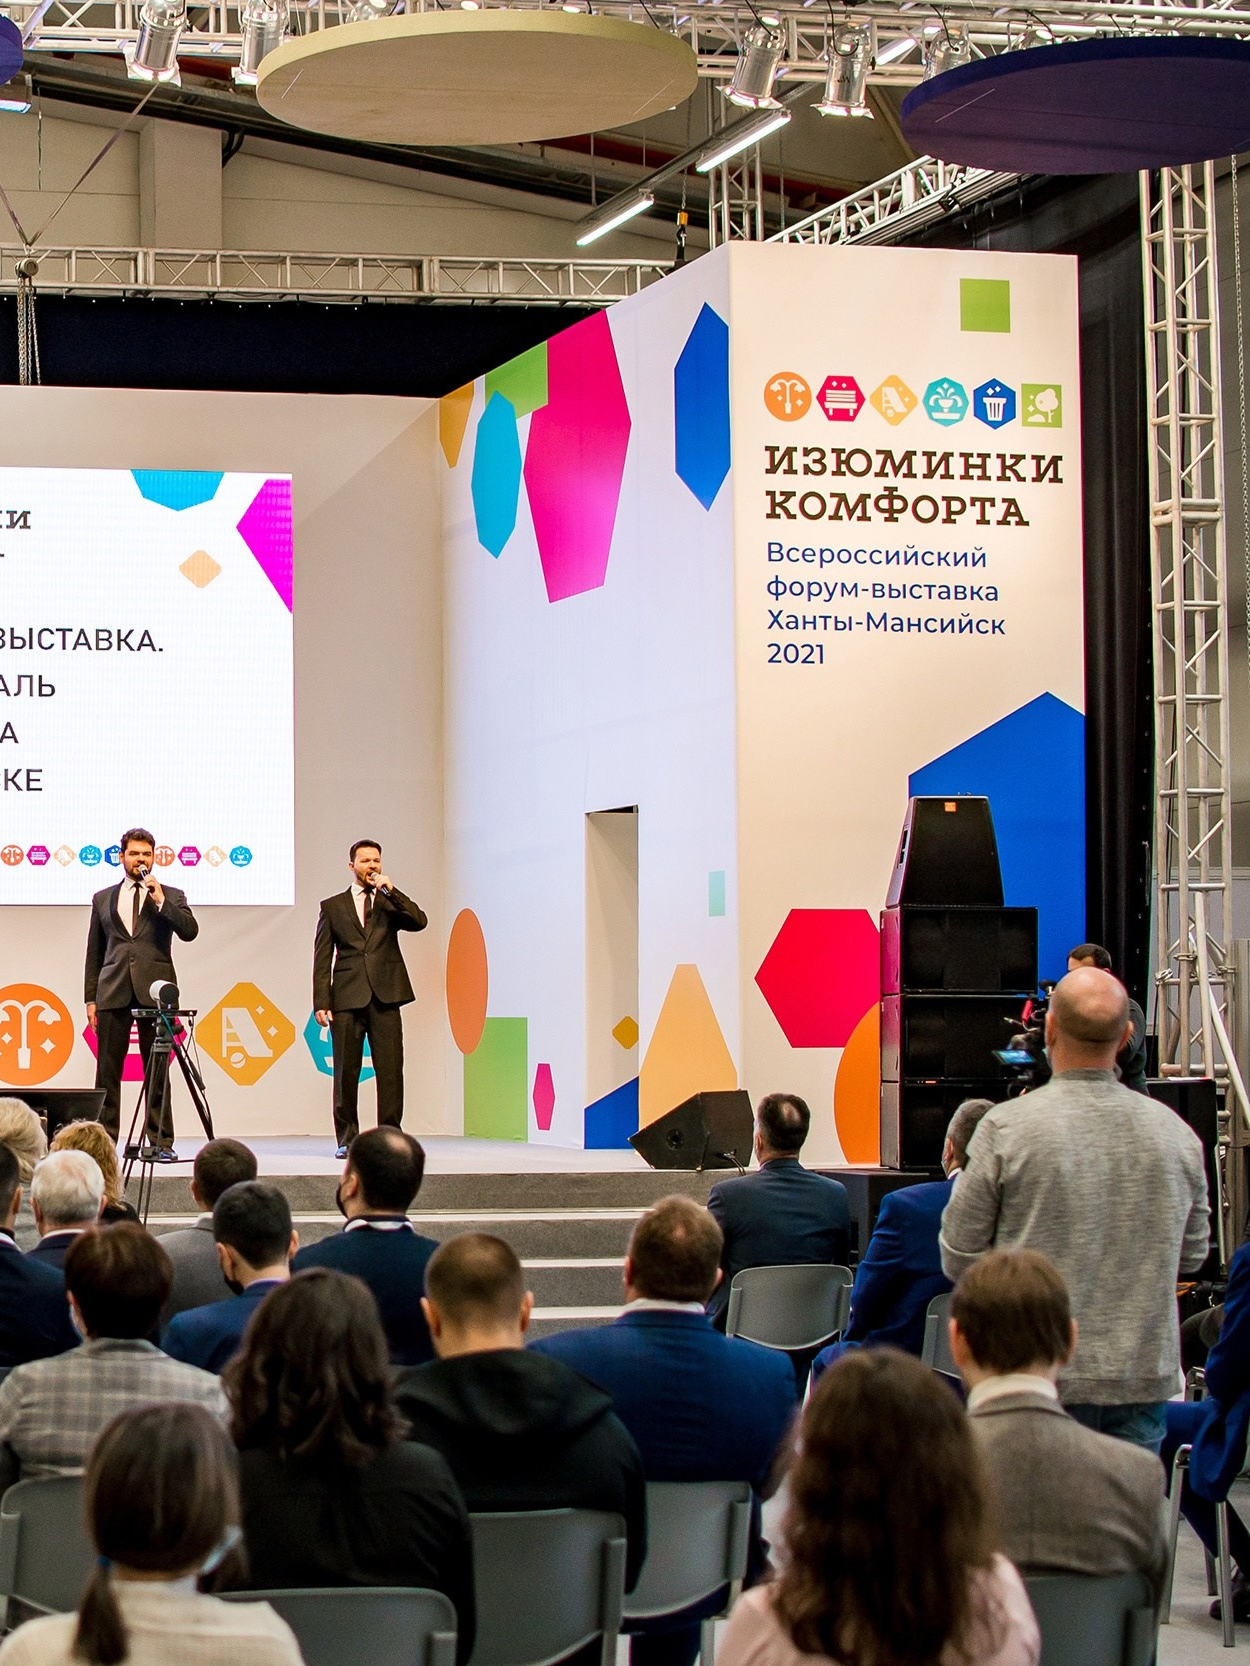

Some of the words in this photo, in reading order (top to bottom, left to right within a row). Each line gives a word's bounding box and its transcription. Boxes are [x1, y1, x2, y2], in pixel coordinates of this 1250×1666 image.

[764, 445, 1064, 484] ИЗЮМИНКИ
[765, 485, 1030, 527] КОМФОРТА
[767, 541, 986, 569] Всероссийский
[766, 574, 999, 603] форум-выставка
[767, 609, 1006, 635] Ханты-Мансийск
[767, 642, 824, 665] 2021
